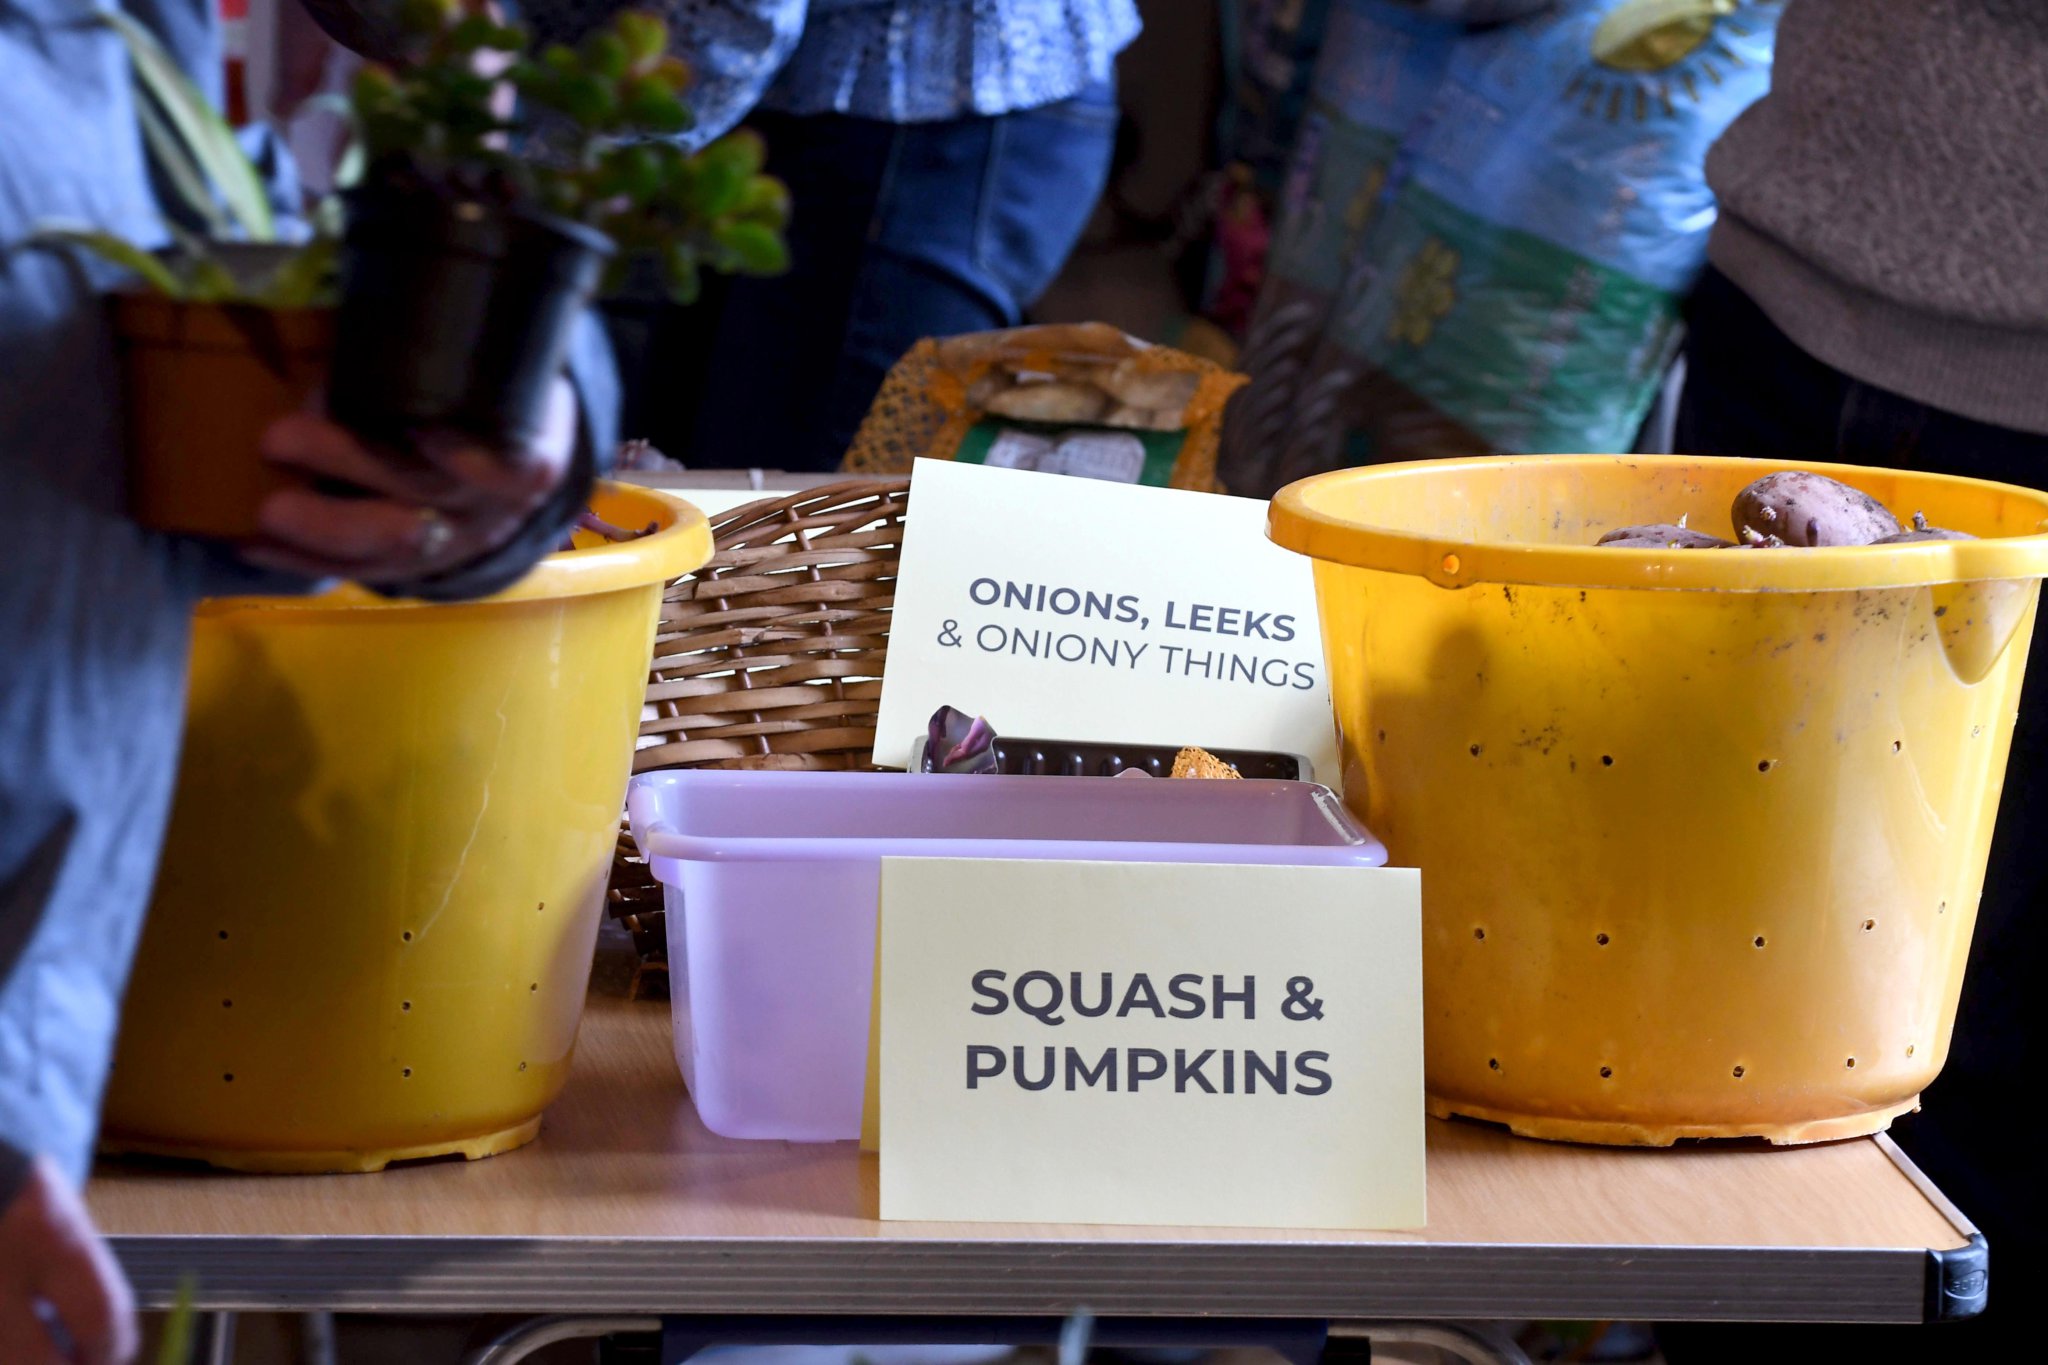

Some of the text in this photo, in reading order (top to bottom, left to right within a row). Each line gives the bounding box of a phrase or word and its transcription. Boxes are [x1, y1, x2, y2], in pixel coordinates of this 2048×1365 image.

[969, 577, 1295, 642] ONIONS, LEEKS
[937, 619, 1315, 690] & ONIONY THINGS
[970, 969, 1325, 1027] SQUASH &
[966, 1044, 1333, 1096] PUMPKINS
